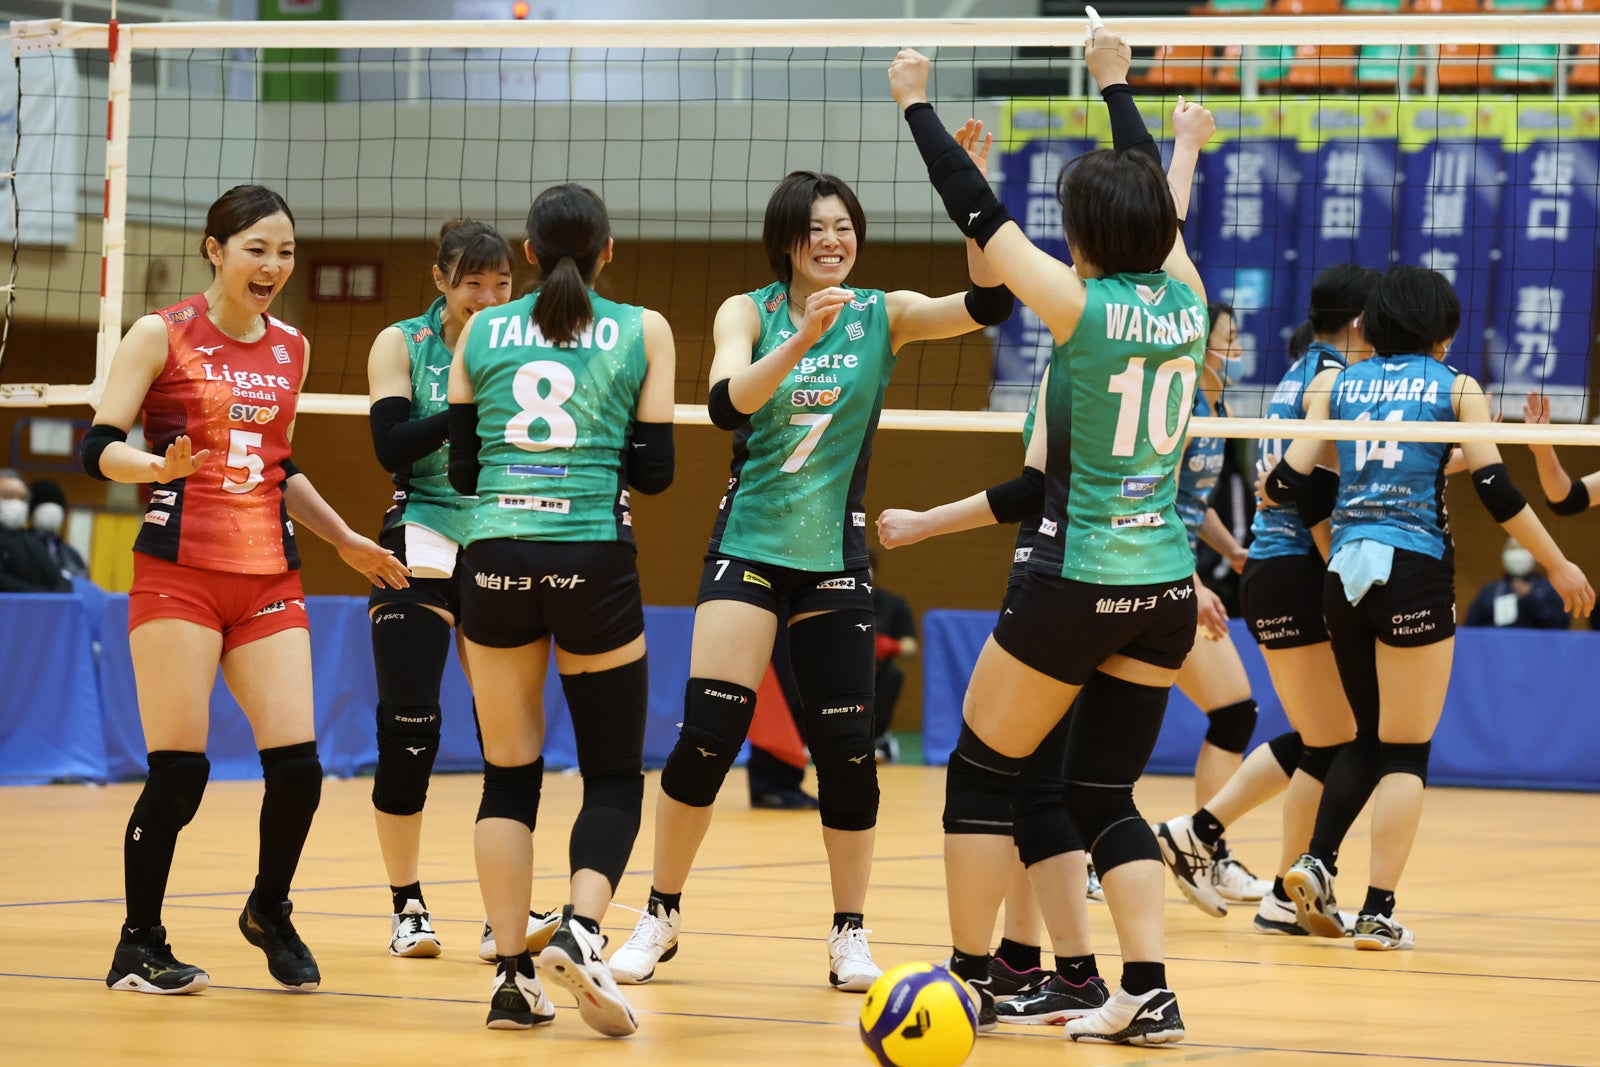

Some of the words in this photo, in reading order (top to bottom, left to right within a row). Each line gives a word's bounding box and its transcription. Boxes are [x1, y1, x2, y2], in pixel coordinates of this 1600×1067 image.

[488, 315, 619, 351] TAKNO
[201, 363, 291, 390] Ligare
[793, 353, 859, 375] gare
[794, 373, 838, 384] Sendai
[232, 387, 278, 402] Sendai
[504, 360, 577, 452] 8
[1108, 355, 1197, 457] 10
[1337, 377, 1439, 405] FUJIWARA
[778, 413, 833, 473] 7
[1355, 409, 1405, 471] 14
[222, 429, 265, 494] 5
[714, 560, 730, 581] 7
